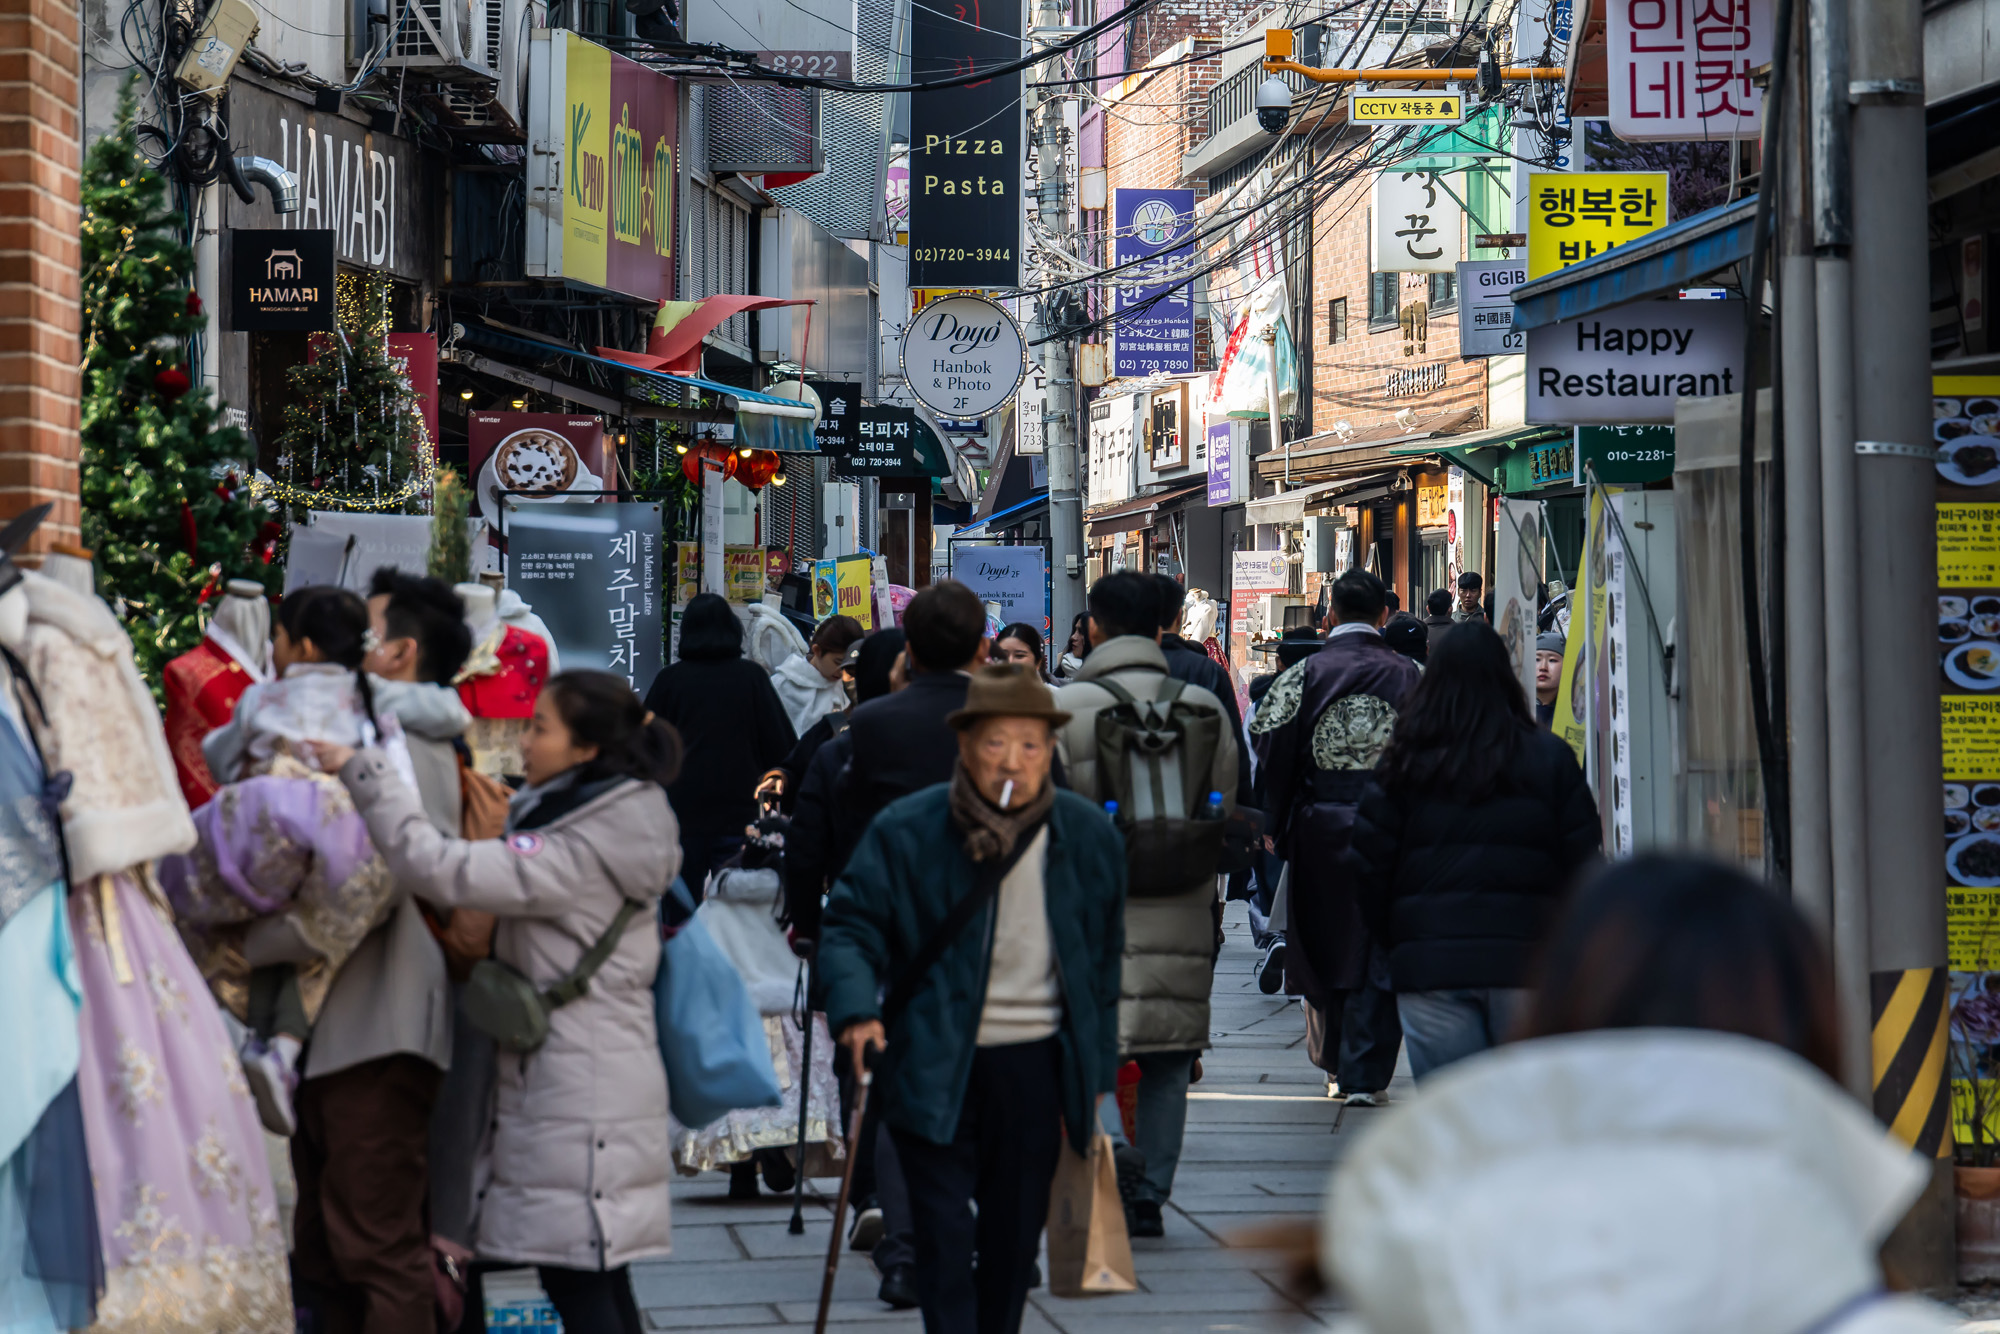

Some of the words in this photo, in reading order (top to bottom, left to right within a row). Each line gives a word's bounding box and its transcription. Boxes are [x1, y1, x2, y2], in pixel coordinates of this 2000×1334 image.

[1628, 0, 1751, 52] 인생
[1629, 59, 1754, 119] 네컷
[1360, 103, 1396, 115] CCTV
[1401, 102, 1435, 115] 작동중
[925, 135, 1003, 154] Pizza
[280, 118, 396, 268] HAMABI
[924, 176, 1005, 195] Pasta
[1539, 187, 1657, 228] 행복한
[915, 249, 1011, 262] 02)720-3944
[249, 287, 319, 302] HAMABI
[1164, 317, 1190, 325] Hanbok
[1503, 333, 1523, 348] 02
[1576, 321, 1694, 356] Happy
[933, 360, 992, 374] Hanbok
[1119, 360, 1137, 371] 02)
[1140, 360, 1160, 369] 720
[1163, 360, 1189, 370] 7890
[933, 377, 943, 389] &
[948, 377, 991, 391] Photo
[1538, 367, 1734, 397] Restaurant
[829, 397, 847, 415] 솔
[953, 397, 969, 409] 2F
[851, 458, 866, 467] (02)
[869, 458, 901, 467] 720-3944
[643, 532, 654, 552] Jeju
[643, 555, 655, 589] Matcha
[744, 572, 760, 580] 100%
[643, 592, 654, 616] Latte
[838, 585, 862, 609] PHO
[1001, 591, 1024, 599] Rental
